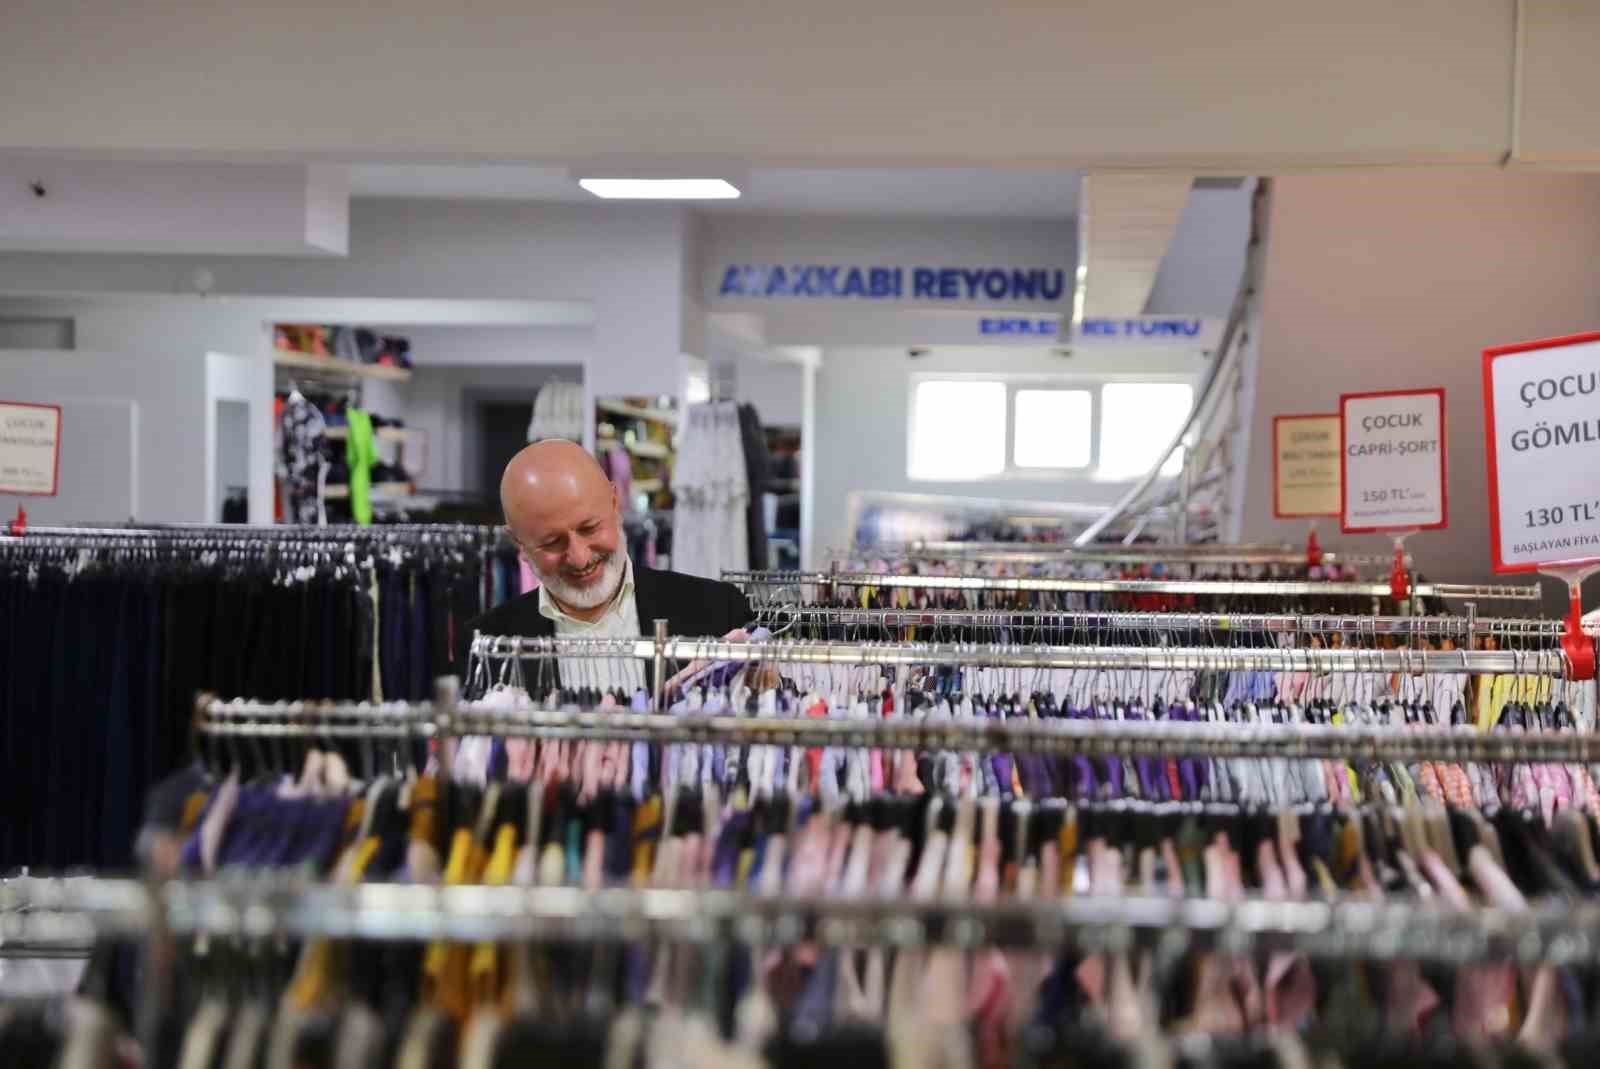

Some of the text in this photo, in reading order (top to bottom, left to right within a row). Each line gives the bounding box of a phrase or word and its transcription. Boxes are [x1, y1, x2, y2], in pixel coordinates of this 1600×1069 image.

[912, 266, 1064, 300] REYONU
[1520, 371, 1600, 409] ÇOCU
[1361, 413, 1423, 432] ÇOCUK
[1348, 440, 1437, 457] CAPRİ-ŞORT
[1362, 489, 1387, 502] 150
[1525, 506, 1563, 529] 130
[1513, 537, 1571, 554] BAŞLAYAN
